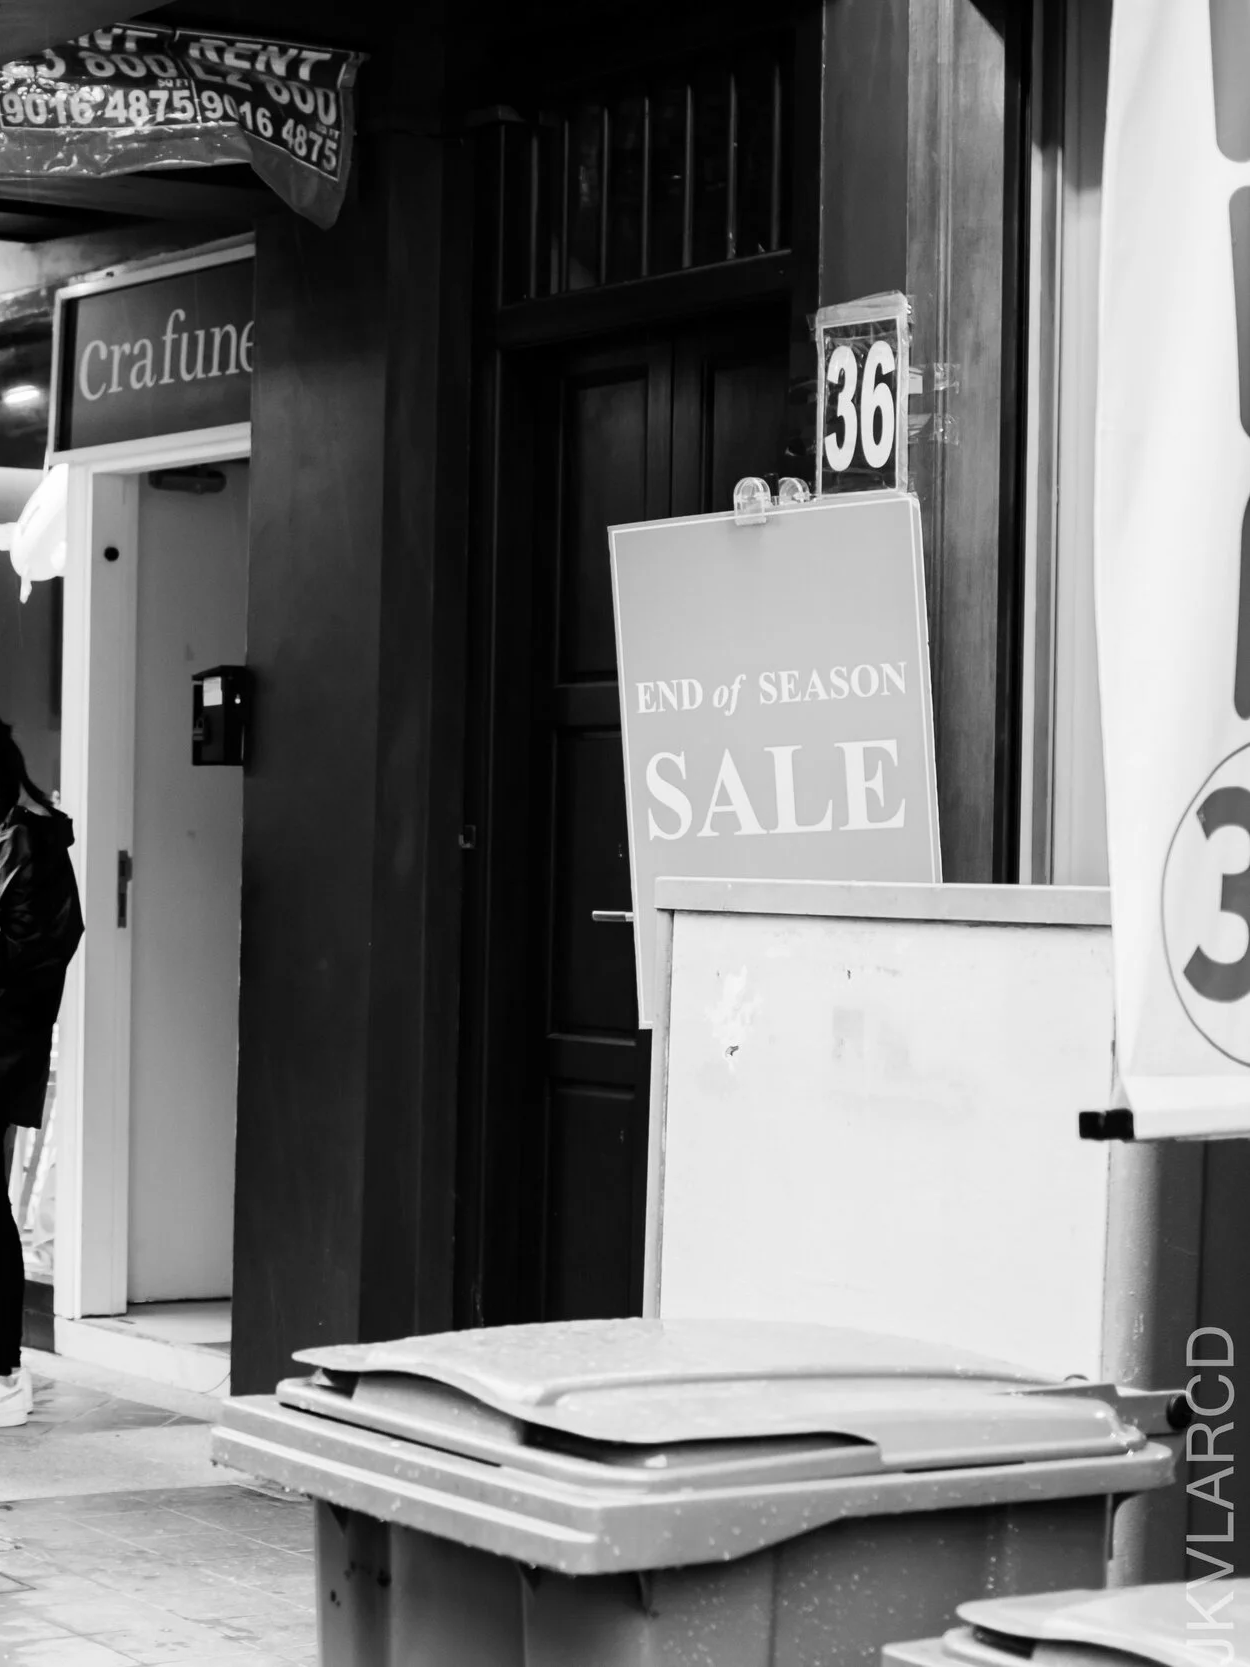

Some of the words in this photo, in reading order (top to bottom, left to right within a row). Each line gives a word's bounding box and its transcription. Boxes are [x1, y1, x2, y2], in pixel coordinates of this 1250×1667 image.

[2, 90, 97, 125] 9016
[104, 89, 195, 127] 4875
[201, 90, 274, 138] 9016
[282, 118, 337, 170] 4875
[824, 340, 896, 472] 36
[635, 678, 704, 714] END
[712, 674, 747, 716] of
[758, 661, 907, 705] SEASON
[646, 739, 906, 841] SALE
